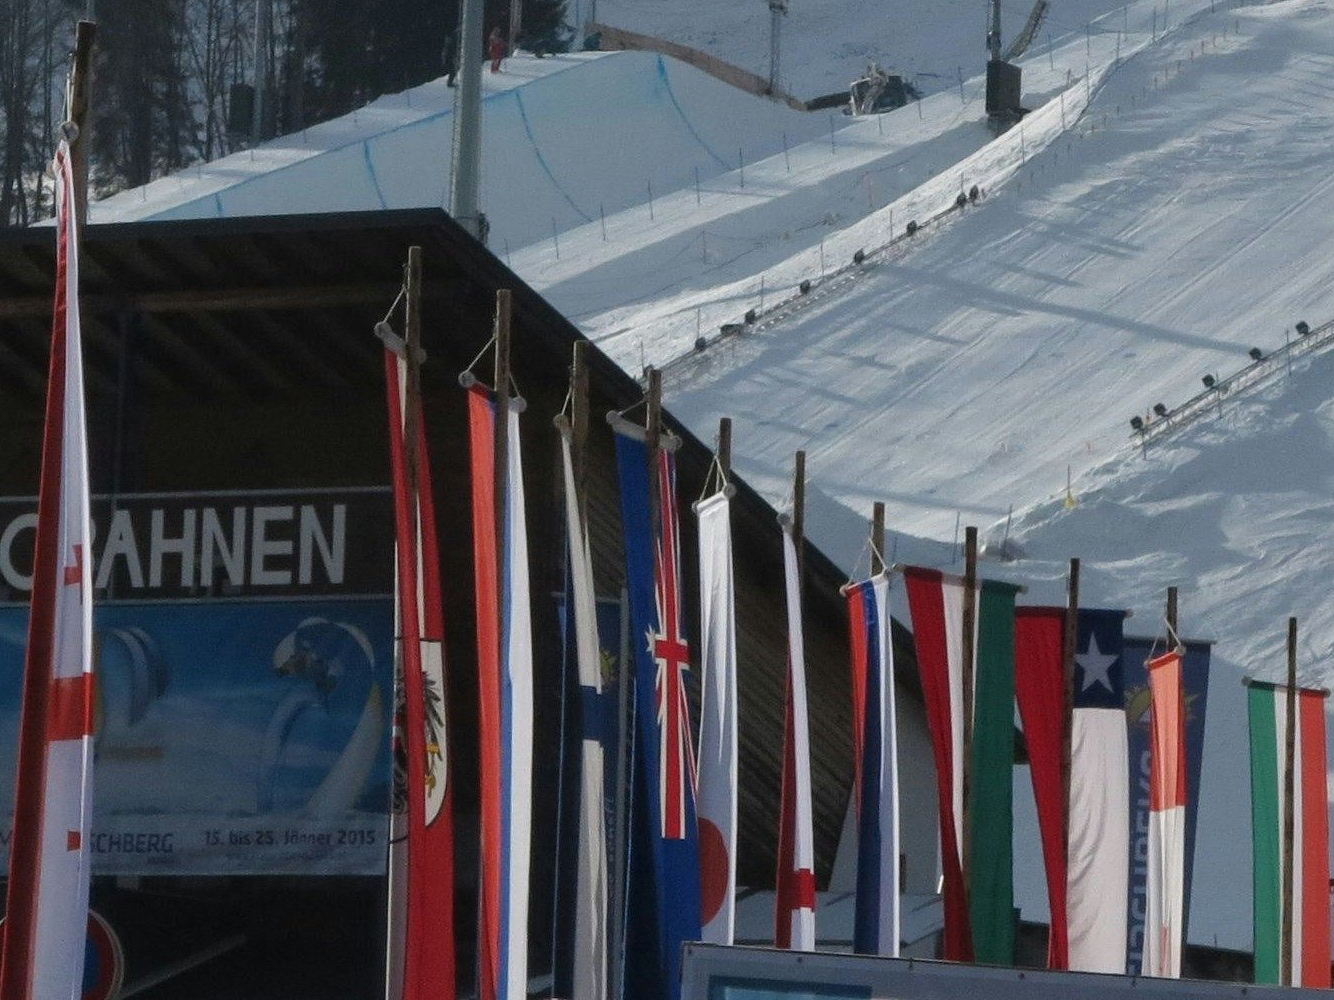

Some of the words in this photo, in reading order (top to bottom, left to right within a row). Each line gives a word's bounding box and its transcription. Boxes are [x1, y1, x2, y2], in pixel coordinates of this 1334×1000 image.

[204, 830, 224, 846] 15.
[229, 829, 251, 845] bis
[256, 830, 278, 845] 25.
[337, 829, 377, 845] 2015
